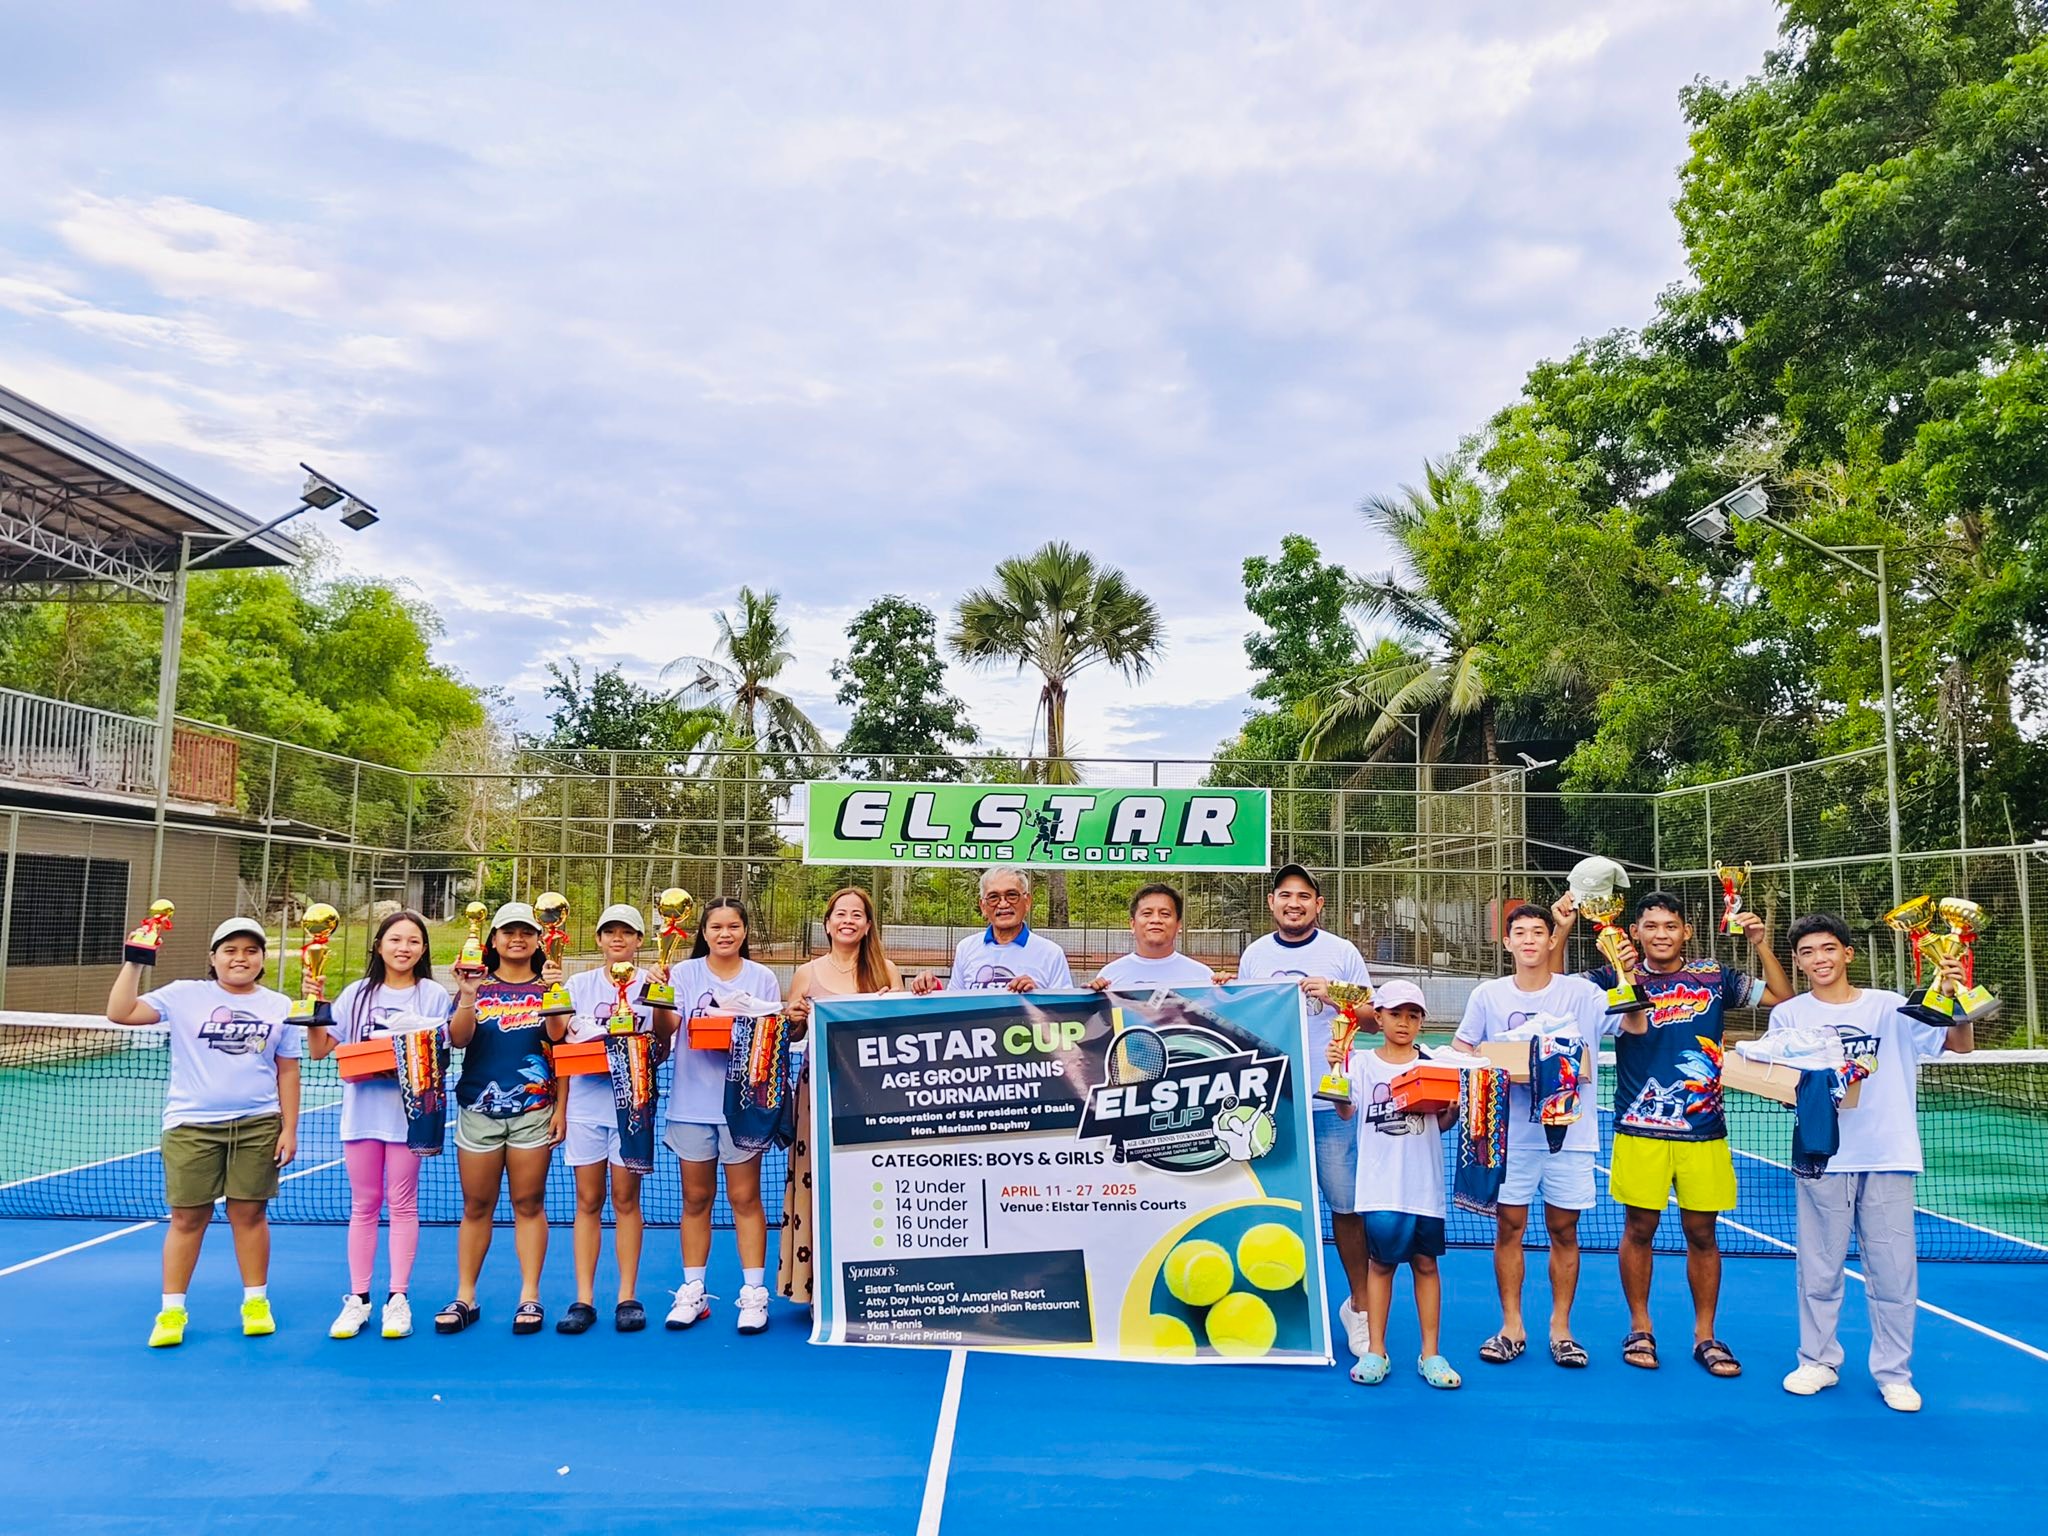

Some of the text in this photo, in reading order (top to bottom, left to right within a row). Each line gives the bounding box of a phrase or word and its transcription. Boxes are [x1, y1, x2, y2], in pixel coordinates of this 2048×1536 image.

[834, 790, 1237, 846] ELSTAR
[890, 842, 1173, 863] TENNIS COURT
[202, 1023, 270, 1034] ELSTAR
[857, 1021, 1086, 1067] ELSTAR CUP
[1844, 1040, 1877, 1054] TAR
[606, 1045, 628, 1109] TANKER
[881, 1060, 1065, 1089] AGE GROUP TENNIS
[905, 1082, 1042, 1107] TOURNAMENT
[1094, 1066, 1269, 1121] ELSTAR
[865, 1117, 877, 1126] In
[878, 1111, 943, 1126] Cooperation
[946, 1110, 957, 1120] of
[959, 1109, 975, 1119] SK
[977, 1106, 1028, 1120] president
[1031, 1104, 1043, 1114] of
[1369, 1104, 1394, 1117] ELS
[1149, 1107, 1205, 1131] CUP
[911, 1125, 935, 1136] Hon.
[989, 1119, 1030, 1133] Daphny
[871, 1151, 1105, 1168] CATEGORIES: BOYS & GIRLS
[895, 1179, 966, 1194] 12 Under
[1000, 1185, 1041, 1198] APRIL
[1045, 1185, 1061, 1197] 11
[1076, 1185, 1093, 1196] 27
[1102, 1184, 1137, 1196] 2025
[895, 1197, 968, 1212] 14 Under
[1000, 1202, 1044, 1213] Venue
[1051, 1200, 1089, 1213] Elstar
[1092, 1200, 1138, 1212] Tennis
[1140, 1198, 1187, 1212] Courts
[896, 1215, 969, 1230] 16 Under
[896, 1233, 969, 1248] 18 Under
[864, 1284, 892, 1294] Elstar
[894, 1282, 925, 1293] Tennis
[927, 1281, 955, 1292] Court
[946, 1292, 960, 1302] Of
[1011, 1288, 1046, 1300] Resort
[866, 1308, 890, 1319] Boss
[891, 1307, 922, 1318] Lakan
[923, 1305, 936, 1316] Of
[938, 1302, 990, 1316] Bollywood
[990, 1300, 1023, 1313] Indian
[1025, 1299, 1081, 1311] Restaurant
[867, 1321, 890, 1331] Ykm
[891, 1318, 923, 1330] Tennis
[889, 1330, 922, 1341] T-shirt
[923, 1329, 962, 1342] Printing
